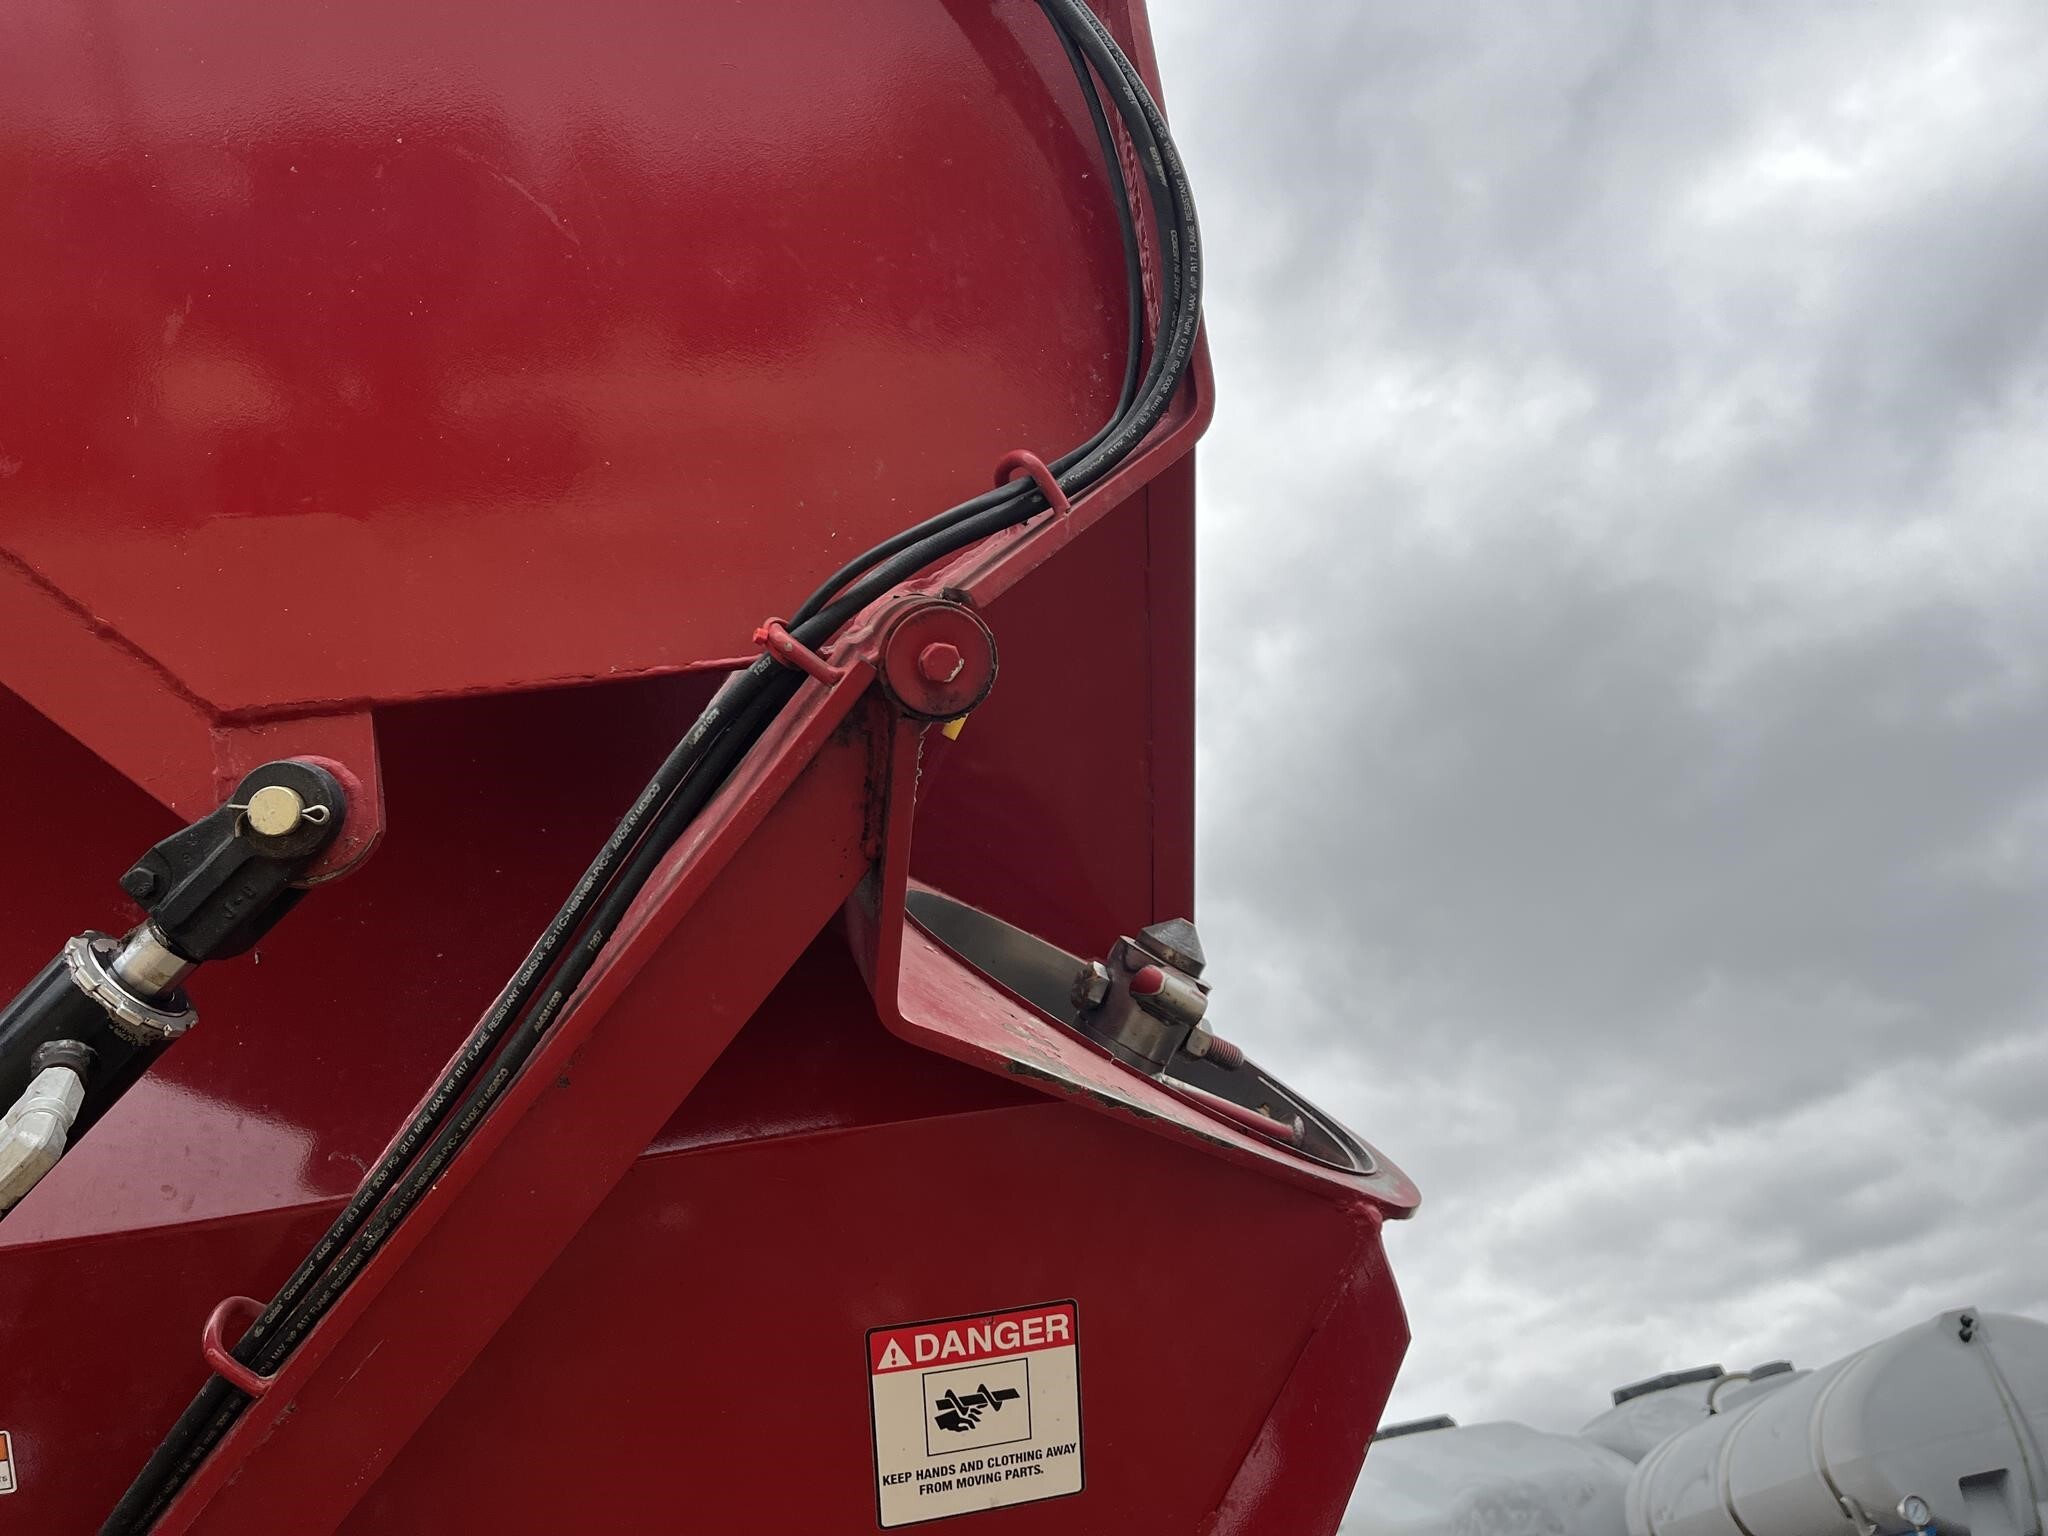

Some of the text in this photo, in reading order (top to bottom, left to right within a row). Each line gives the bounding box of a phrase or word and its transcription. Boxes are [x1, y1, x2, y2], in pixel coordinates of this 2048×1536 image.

[1160, 374, 1174, 393] 3000
[1170, 360, 1181, 373] PSI
[1188, 293, 1196, 311] MAX
[429, 1093, 447, 1113] MAX
[443, 1078, 457, 1093] WP
[454, 1061, 469, 1078] R17
[467, 1031, 490, 1061] FLAME
[486, 987, 521, 1032] RESISTANT
[610, 822, 632, 850] MADE
[626, 813, 639, 826] IN
[459, 1106, 481, 1131] MADE
[915, 1313, 1069, 1363] DANGER
[882, 1442, 1077, 1487] KEEP HANDS AND CLOTHING AWAY
[919, 1465, 1044, 1496] FROM MOVING PARTS.
